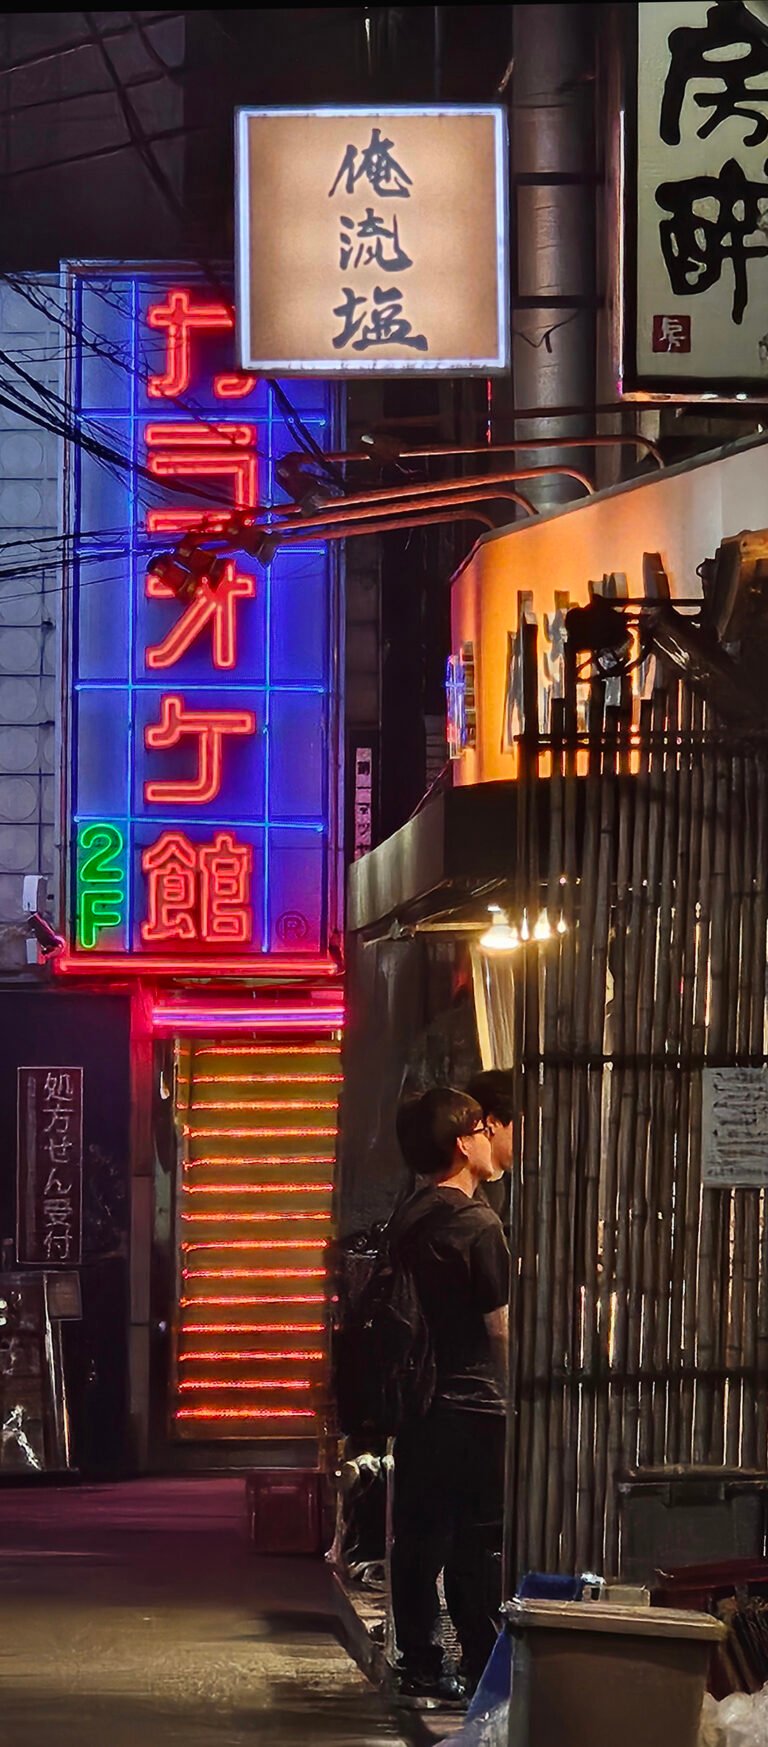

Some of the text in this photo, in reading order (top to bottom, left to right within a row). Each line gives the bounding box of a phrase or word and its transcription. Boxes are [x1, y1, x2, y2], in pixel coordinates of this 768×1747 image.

[328, 128, 428, 351] 俺流塩
[142, 288, 256, 943] カラオケ館
[80, 823, 124, 948] 2F
[43, 1072, 74, 1260] 処方せん受付
